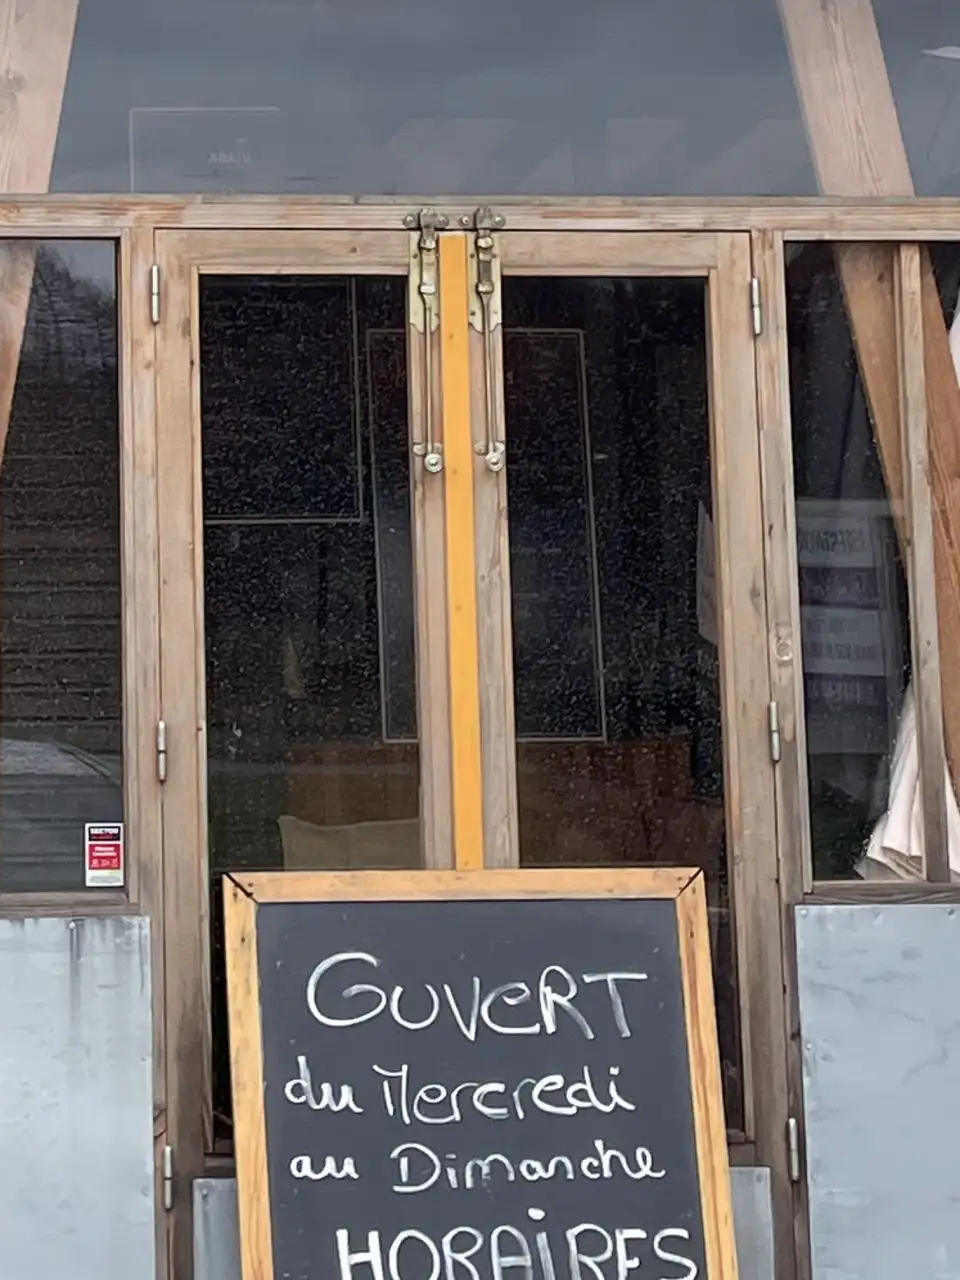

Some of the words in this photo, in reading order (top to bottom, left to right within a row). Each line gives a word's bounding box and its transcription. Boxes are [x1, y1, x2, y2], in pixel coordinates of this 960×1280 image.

[284, 1055, 364, 1113] du
[371, 1063, 636, 1125] Mercredi
[289, 1154, 360, 1181] au
[389, 1138, 667, 1193] Dimanche
